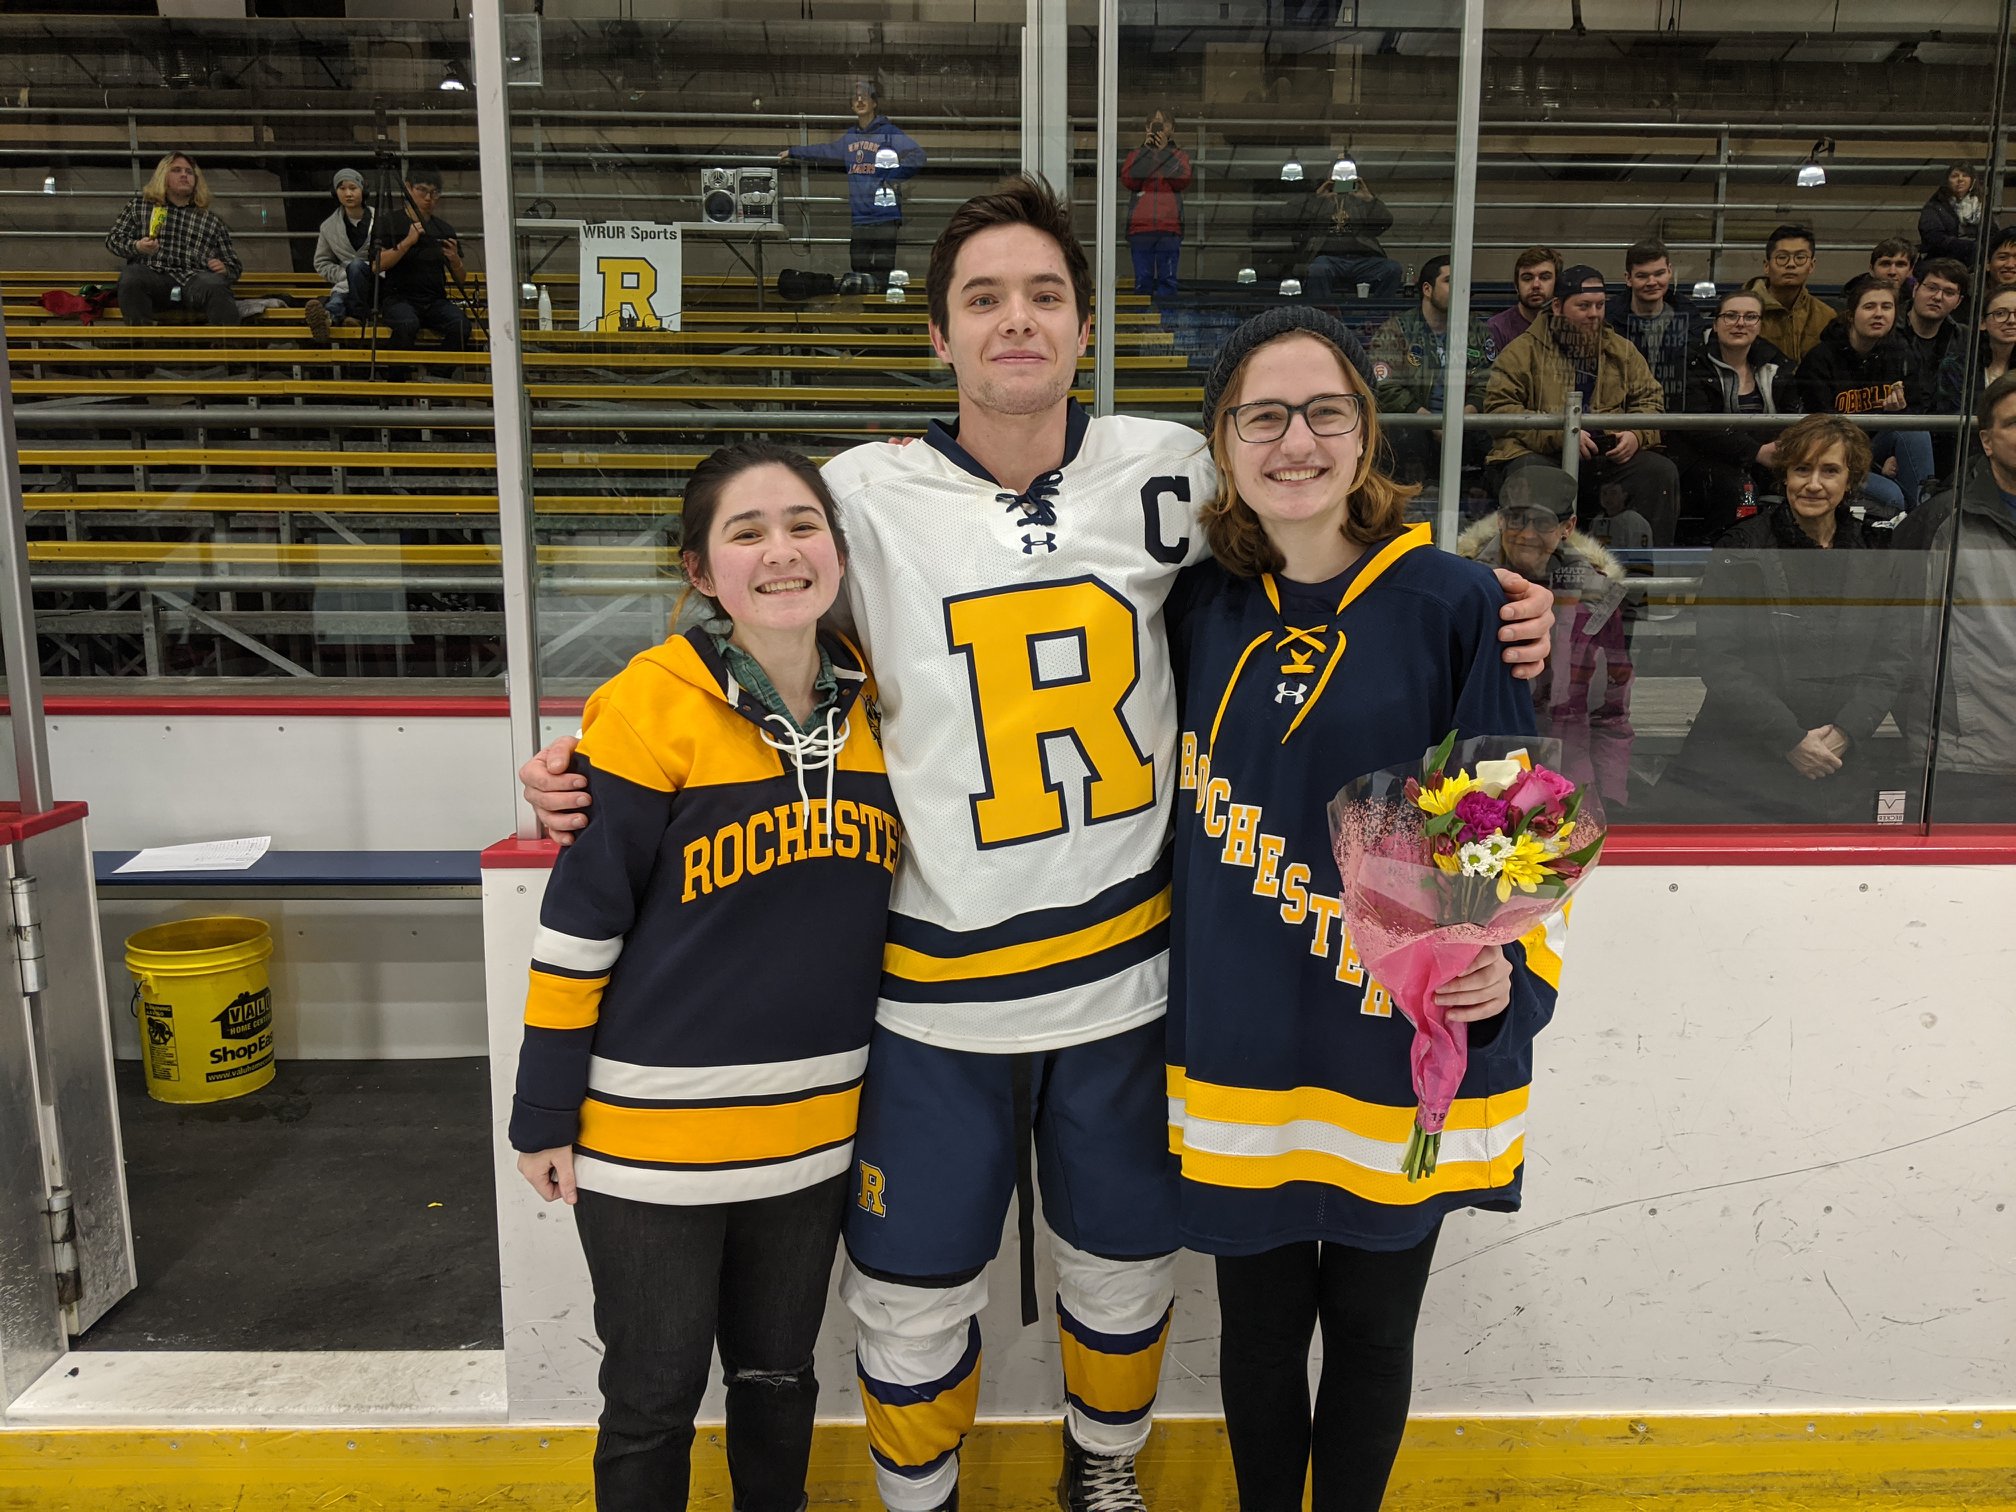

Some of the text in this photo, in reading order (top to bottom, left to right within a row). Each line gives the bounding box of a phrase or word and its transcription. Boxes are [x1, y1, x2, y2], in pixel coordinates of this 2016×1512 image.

[583, 226, 678, 241] WRUR Sports
[596, 256, 663, 332] R
[1835, 384, 1891, 413] OBERLI
[1140, 475, 1191, 564] C
[942, 573, 1157, 851] R
[681, 798, 900, 904] ROCHESTE
[229, 1022, 252, 1036] HOME
[857, 1159, 887, 1218] R
